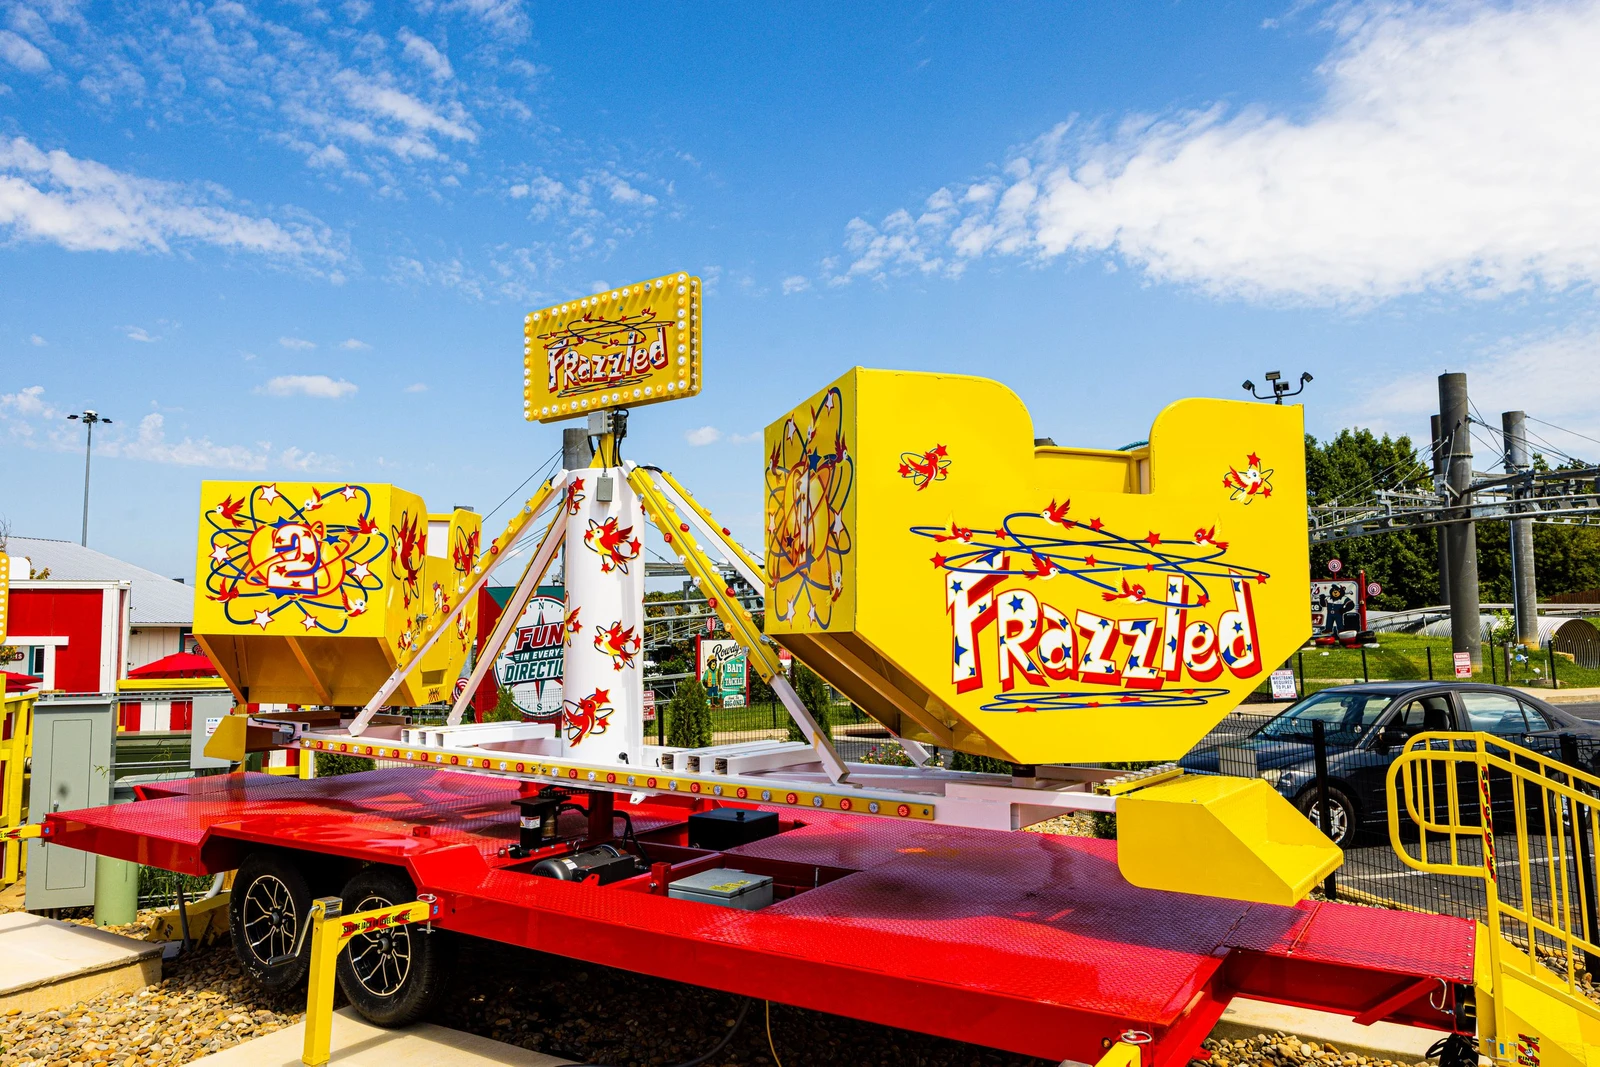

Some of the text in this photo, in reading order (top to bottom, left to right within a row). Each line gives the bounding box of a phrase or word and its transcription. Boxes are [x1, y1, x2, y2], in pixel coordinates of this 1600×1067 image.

[267, 523, 321, 596] 2
[516, 622, 564, 651] FUN
[520, 648, 559, 661] IN EVERY
[727, 664, 743, 673] BAIT
[433, 905, 438, 914] 5
